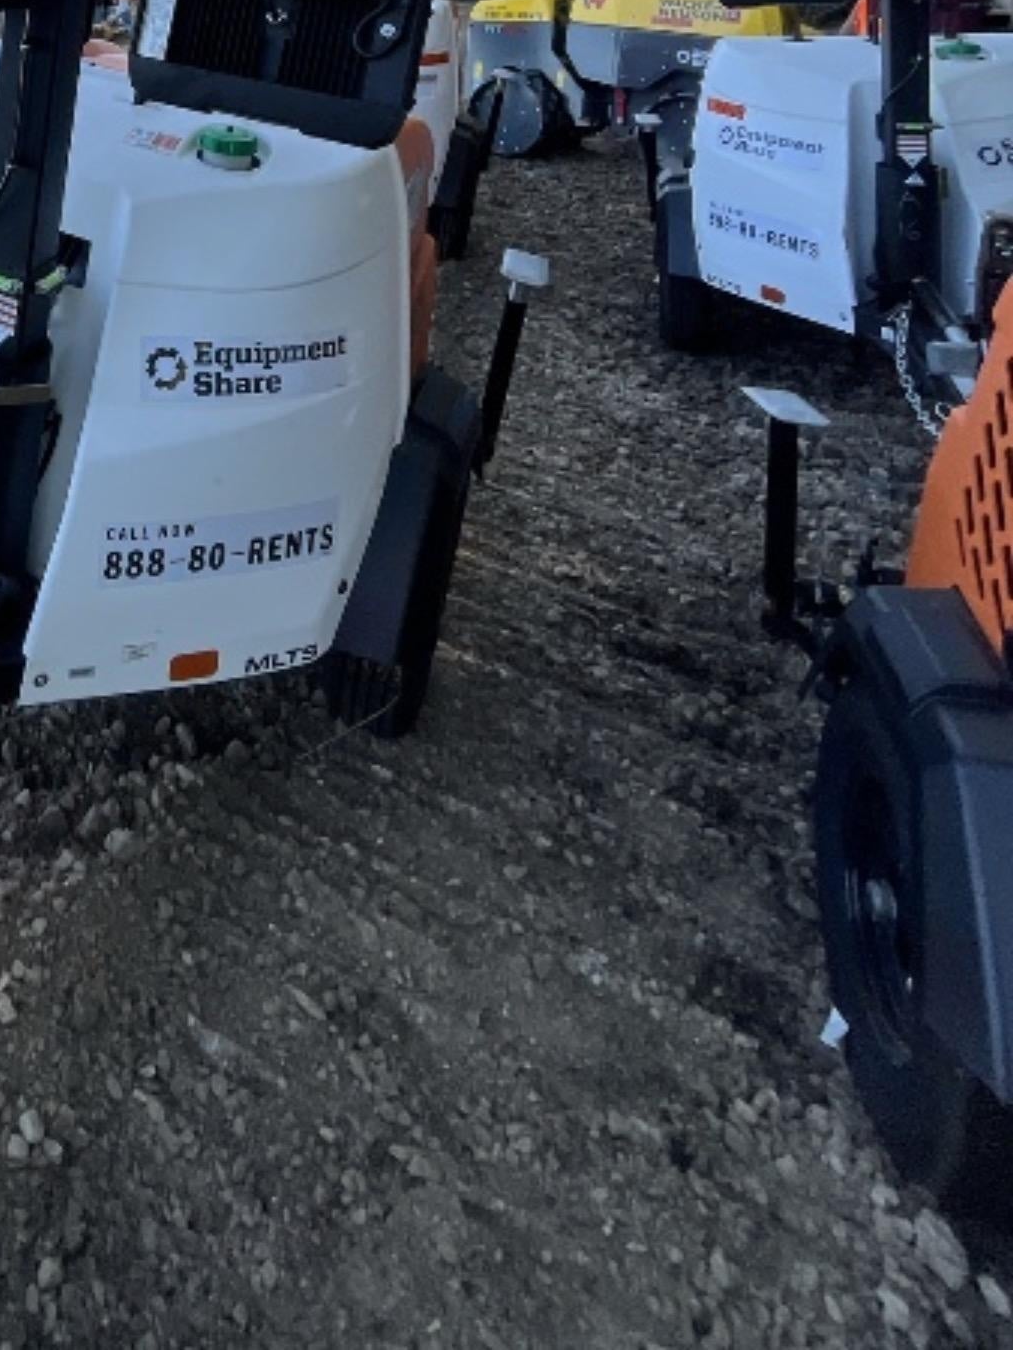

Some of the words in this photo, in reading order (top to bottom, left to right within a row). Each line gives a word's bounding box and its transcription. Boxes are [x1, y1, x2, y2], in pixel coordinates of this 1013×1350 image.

[193, 335, 347, 370] Equipment
[193, 371, 283, 397] Share
[106, 526, 149, 541] CALL
[103, 524, 334, 580] 888-80-RENTS
